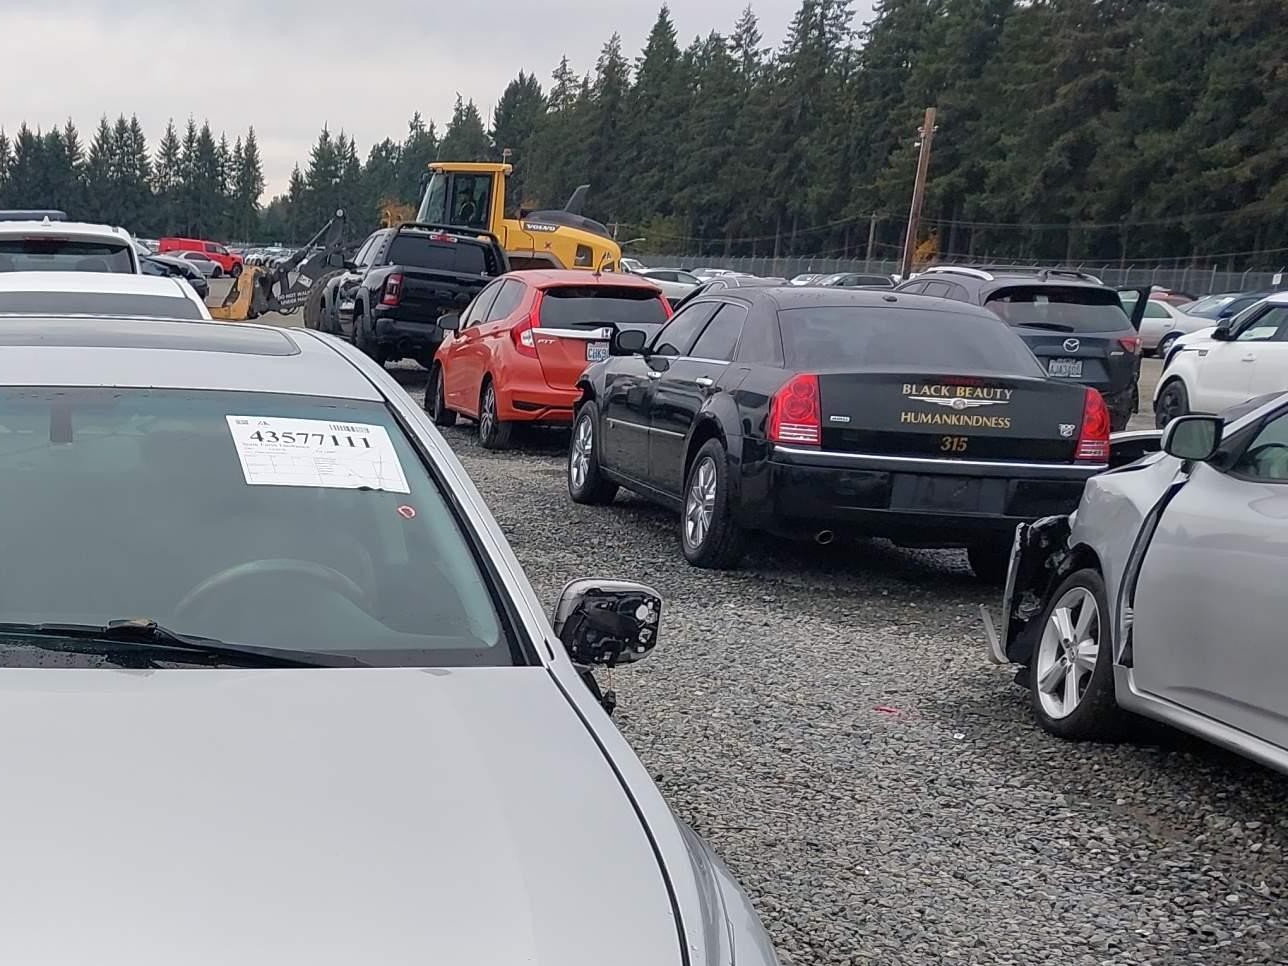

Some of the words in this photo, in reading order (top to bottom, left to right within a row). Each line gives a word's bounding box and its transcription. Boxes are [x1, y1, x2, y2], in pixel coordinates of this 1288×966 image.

[526, 223, 556, 231] VOLVO
[902, 384, 950, 397] BLACK
[956, 386, 1013, 400] BEAUTY
[900, 411, 1011, 429] HUMANKINDNESS
[250, 430, 371, 449] 43577111
[940, 436, 969, 452] 315
